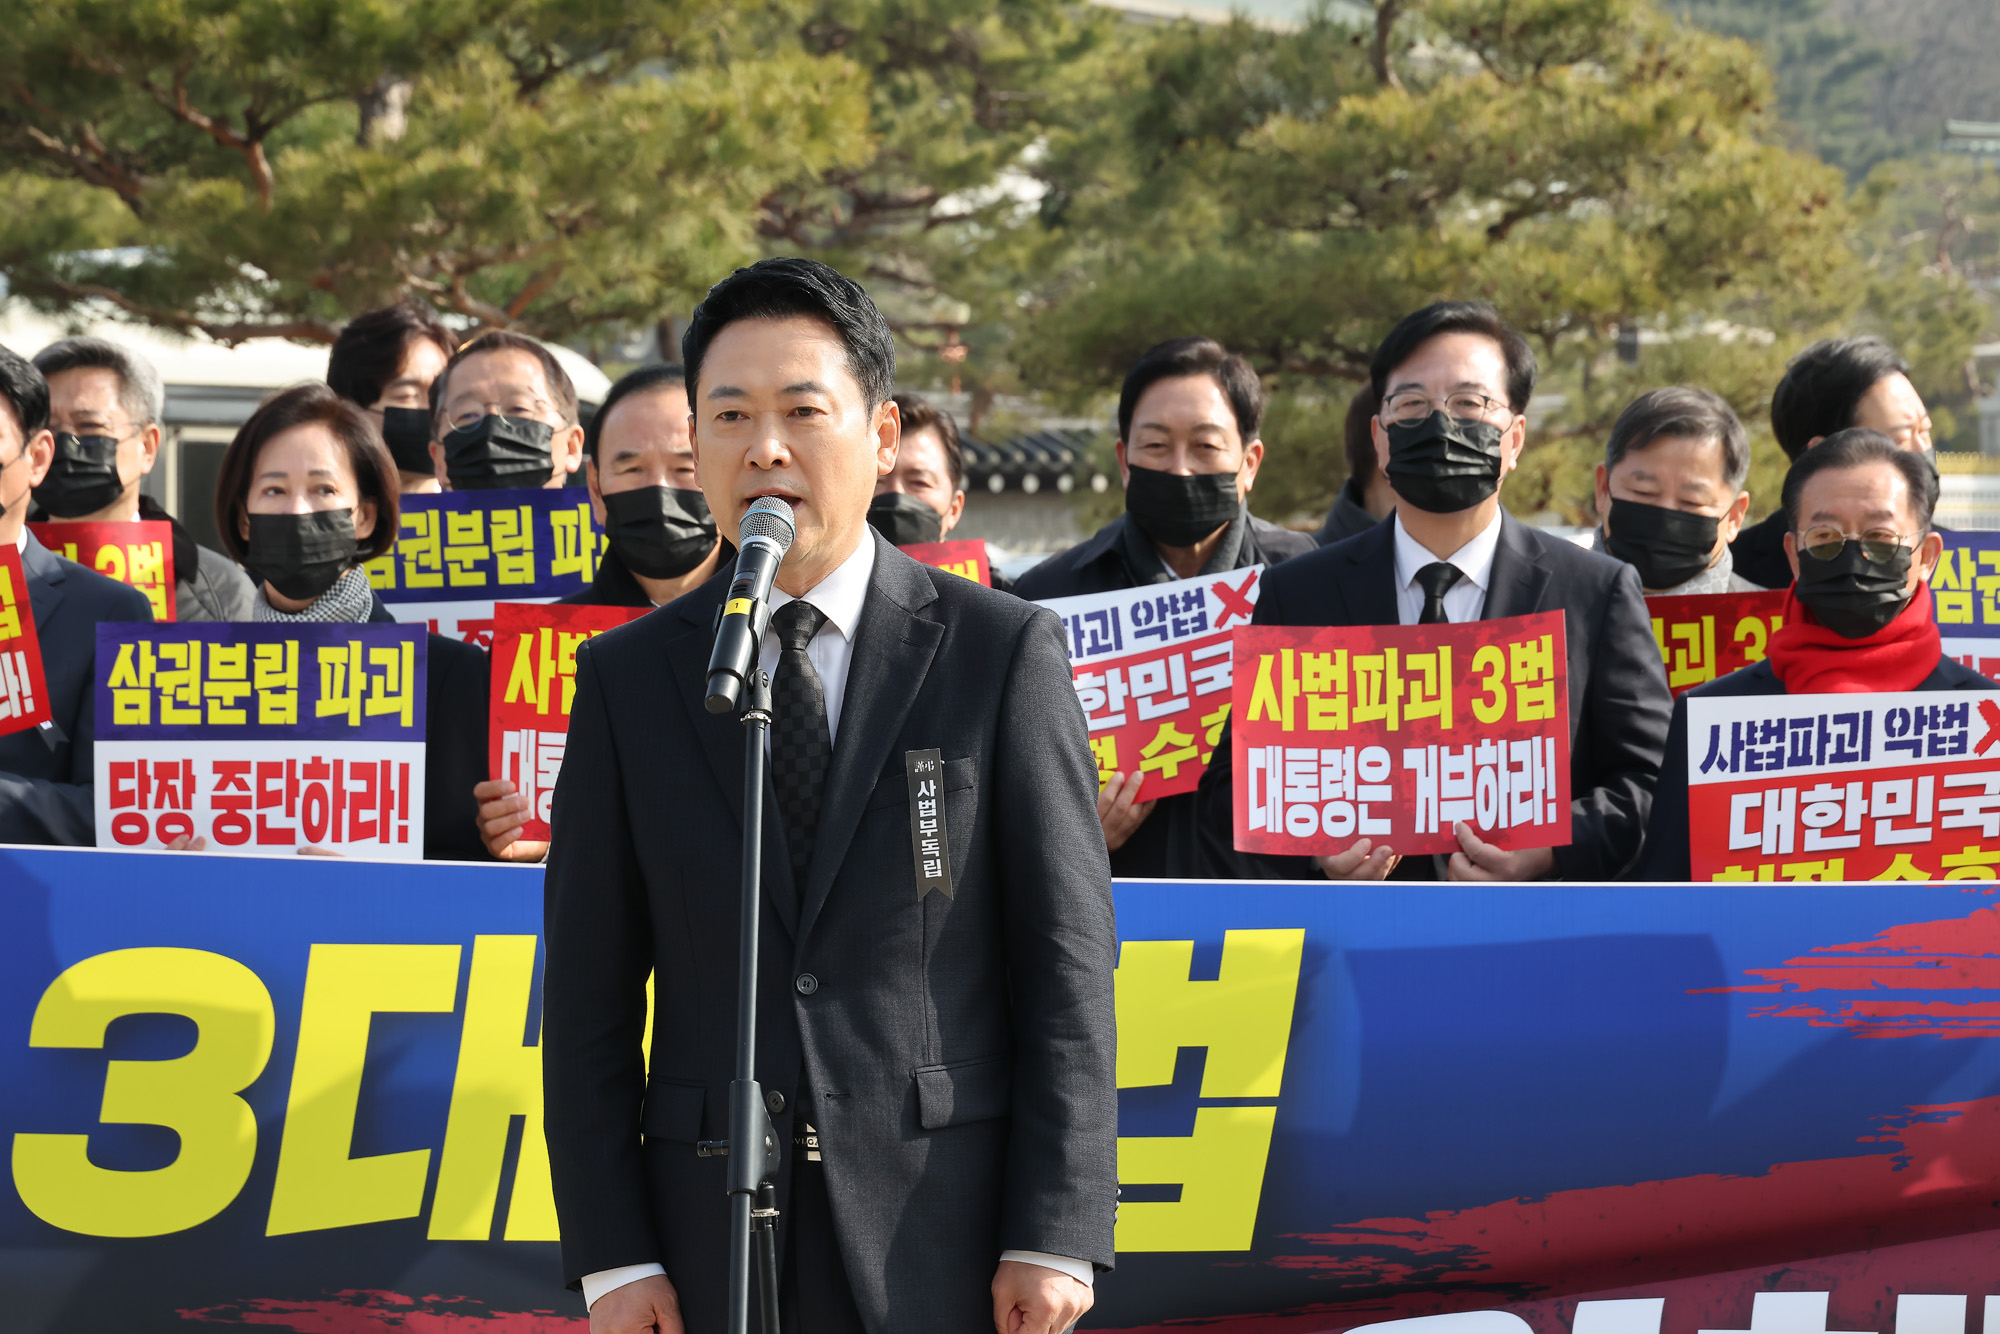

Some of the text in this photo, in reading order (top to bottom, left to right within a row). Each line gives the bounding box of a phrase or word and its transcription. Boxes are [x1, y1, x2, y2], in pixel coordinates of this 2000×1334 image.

[549, 502, 610, 584] 파
[1130, 587, 1208, 642] 악법
[1733, 615, 1783, 672] 3
[107, 640, 415, 728] 삼권분립 파괴
[1246, 634, 1556, 732] 사법파괴 3법
[1699, 702, 1969, 775] 사법파괴 악법
[109, 756, 411, 846] 당장 중단하라!
[1247, 736, 1557, 838] 대통령은 거부하라!
[1728, 771, 2000, 855] 대한민국
[11, 934, 561, 1242] 3대
